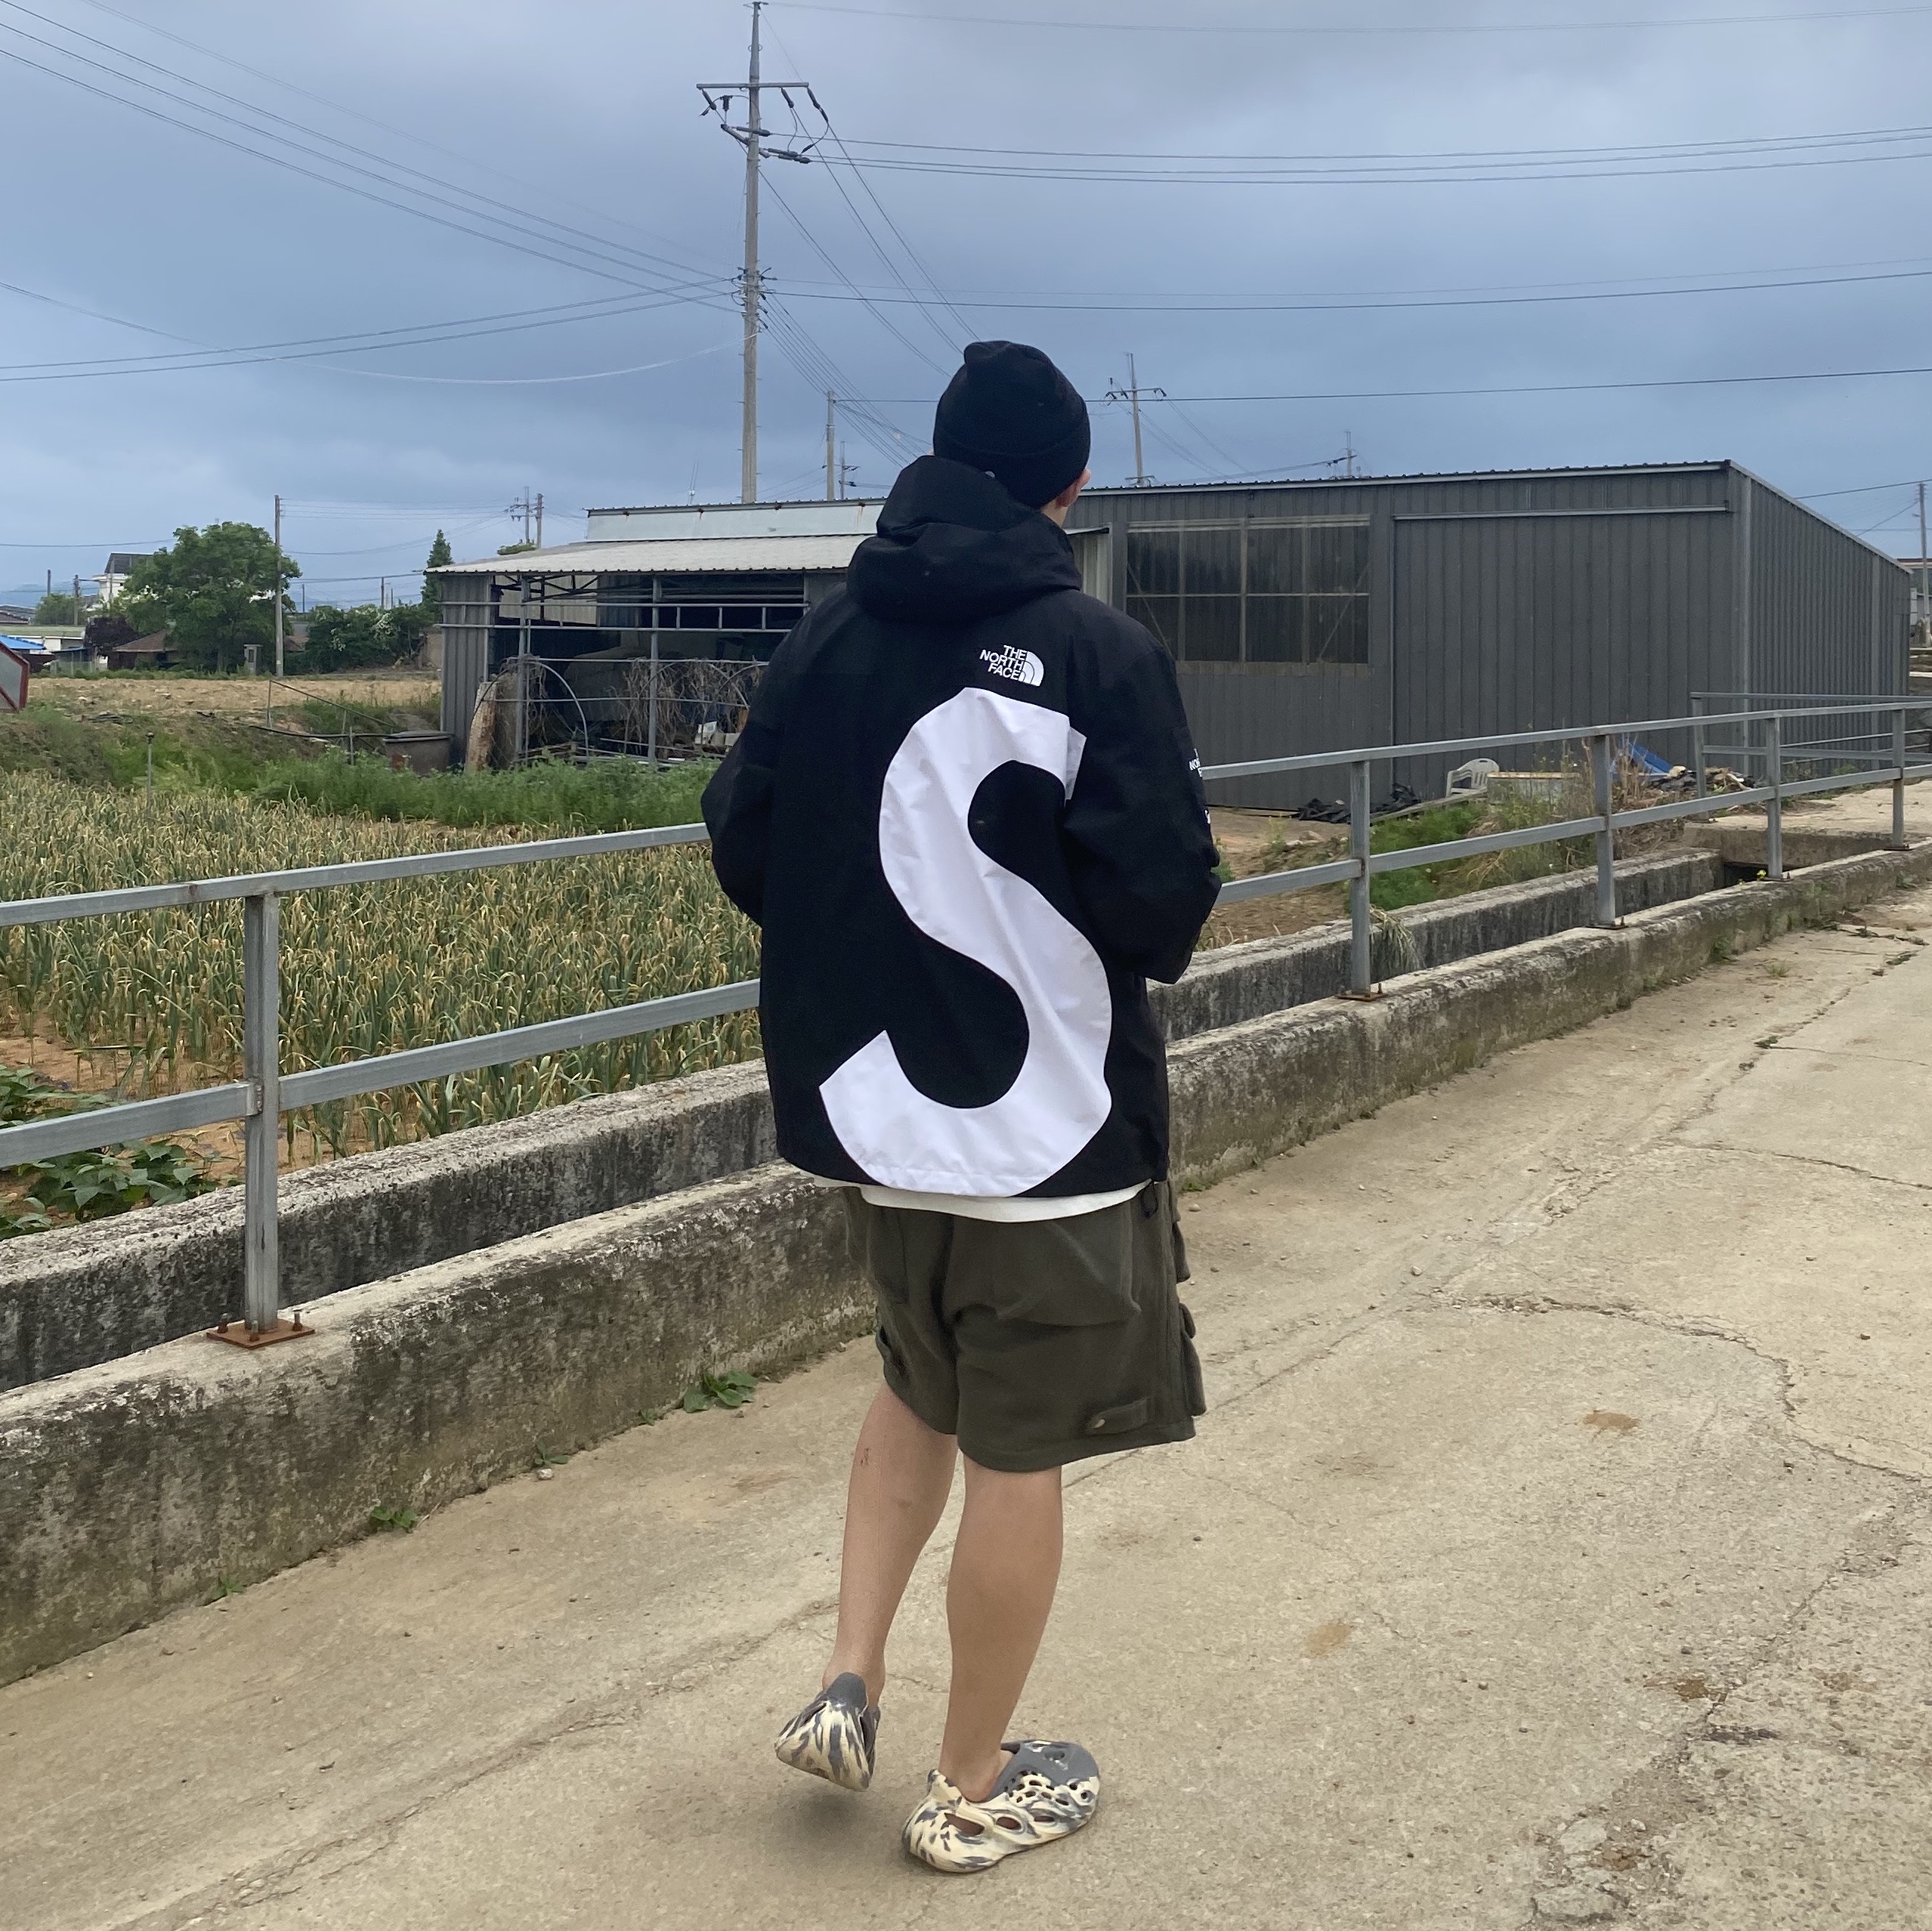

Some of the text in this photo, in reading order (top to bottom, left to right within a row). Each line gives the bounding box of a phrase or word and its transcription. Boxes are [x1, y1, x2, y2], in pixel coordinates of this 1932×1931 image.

[979, 649, 1024, 671] NORTH
[1003, 644, 1027, 660] THE
[988, 662, 1021, 681] FACE
[819, 687, 1112, 1198] S
